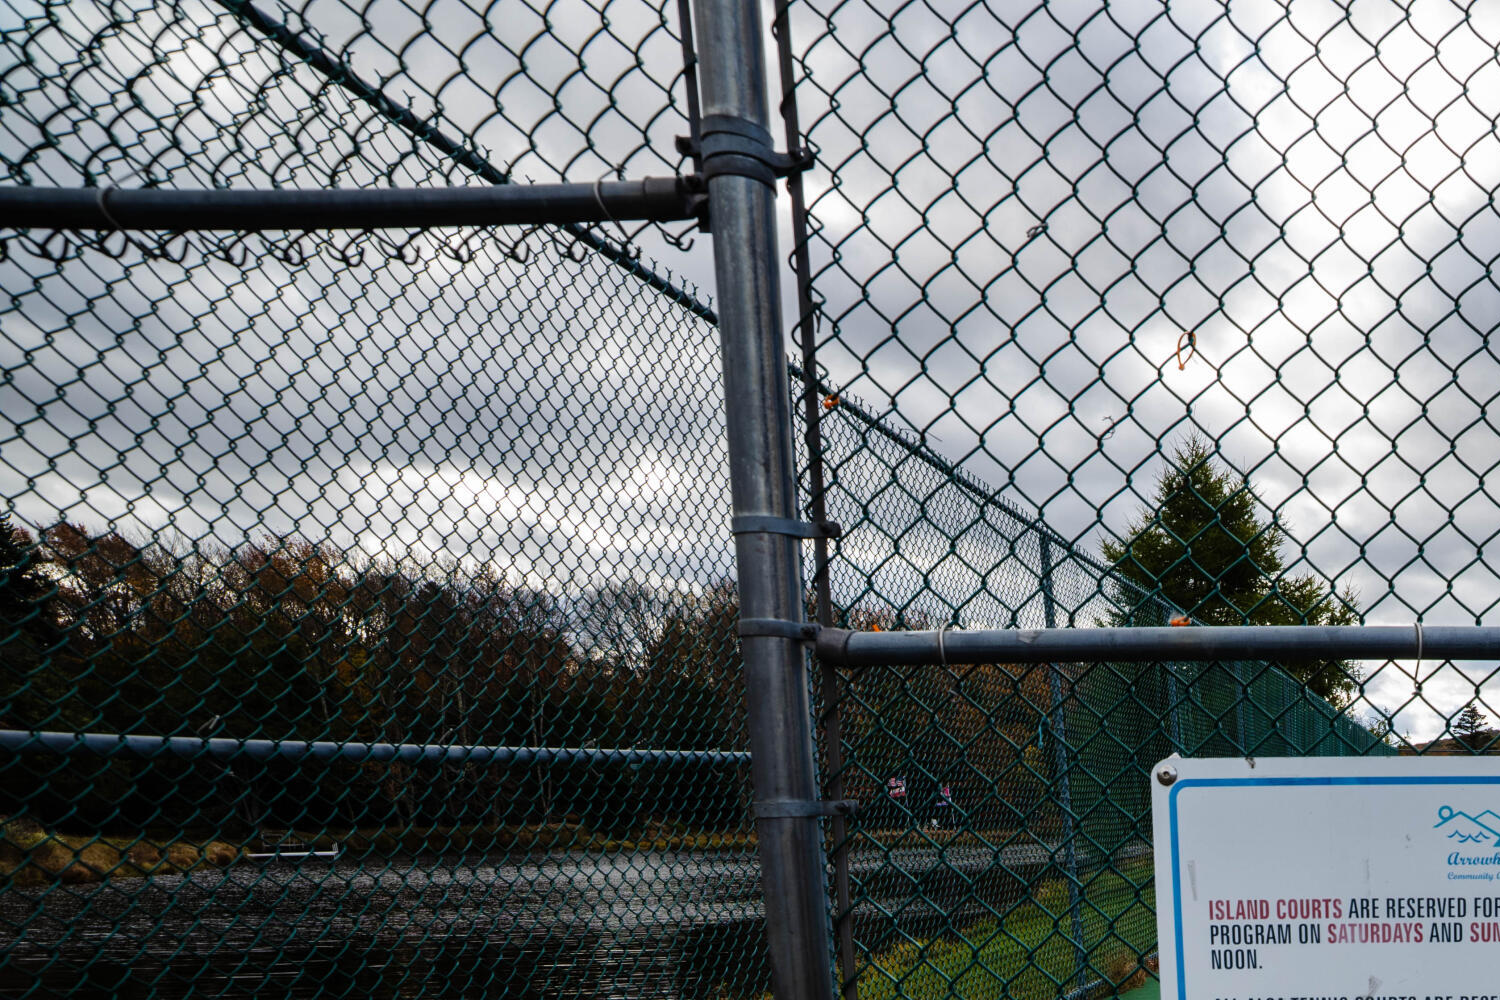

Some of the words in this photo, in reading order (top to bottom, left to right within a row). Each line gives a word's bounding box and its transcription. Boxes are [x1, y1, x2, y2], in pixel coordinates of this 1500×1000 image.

[1447, 871, 1494, 881] Community
[1209, 899, 1269, 920] ISLAND
[1276, 898, 1341, 919] COURTS
[1348, 898, 1379, 918] ARE
[1386, 897, 1466, 918] RESERVED
[1210, 923, 1291, 945] PROGRAM
[1298, 923, 1320, 944] ON
[1328, 922, 1423, 943] SATURDAYS
[1429, 922, 1462, 942] AND
[1211, 948, 1262, 969] NOON.
